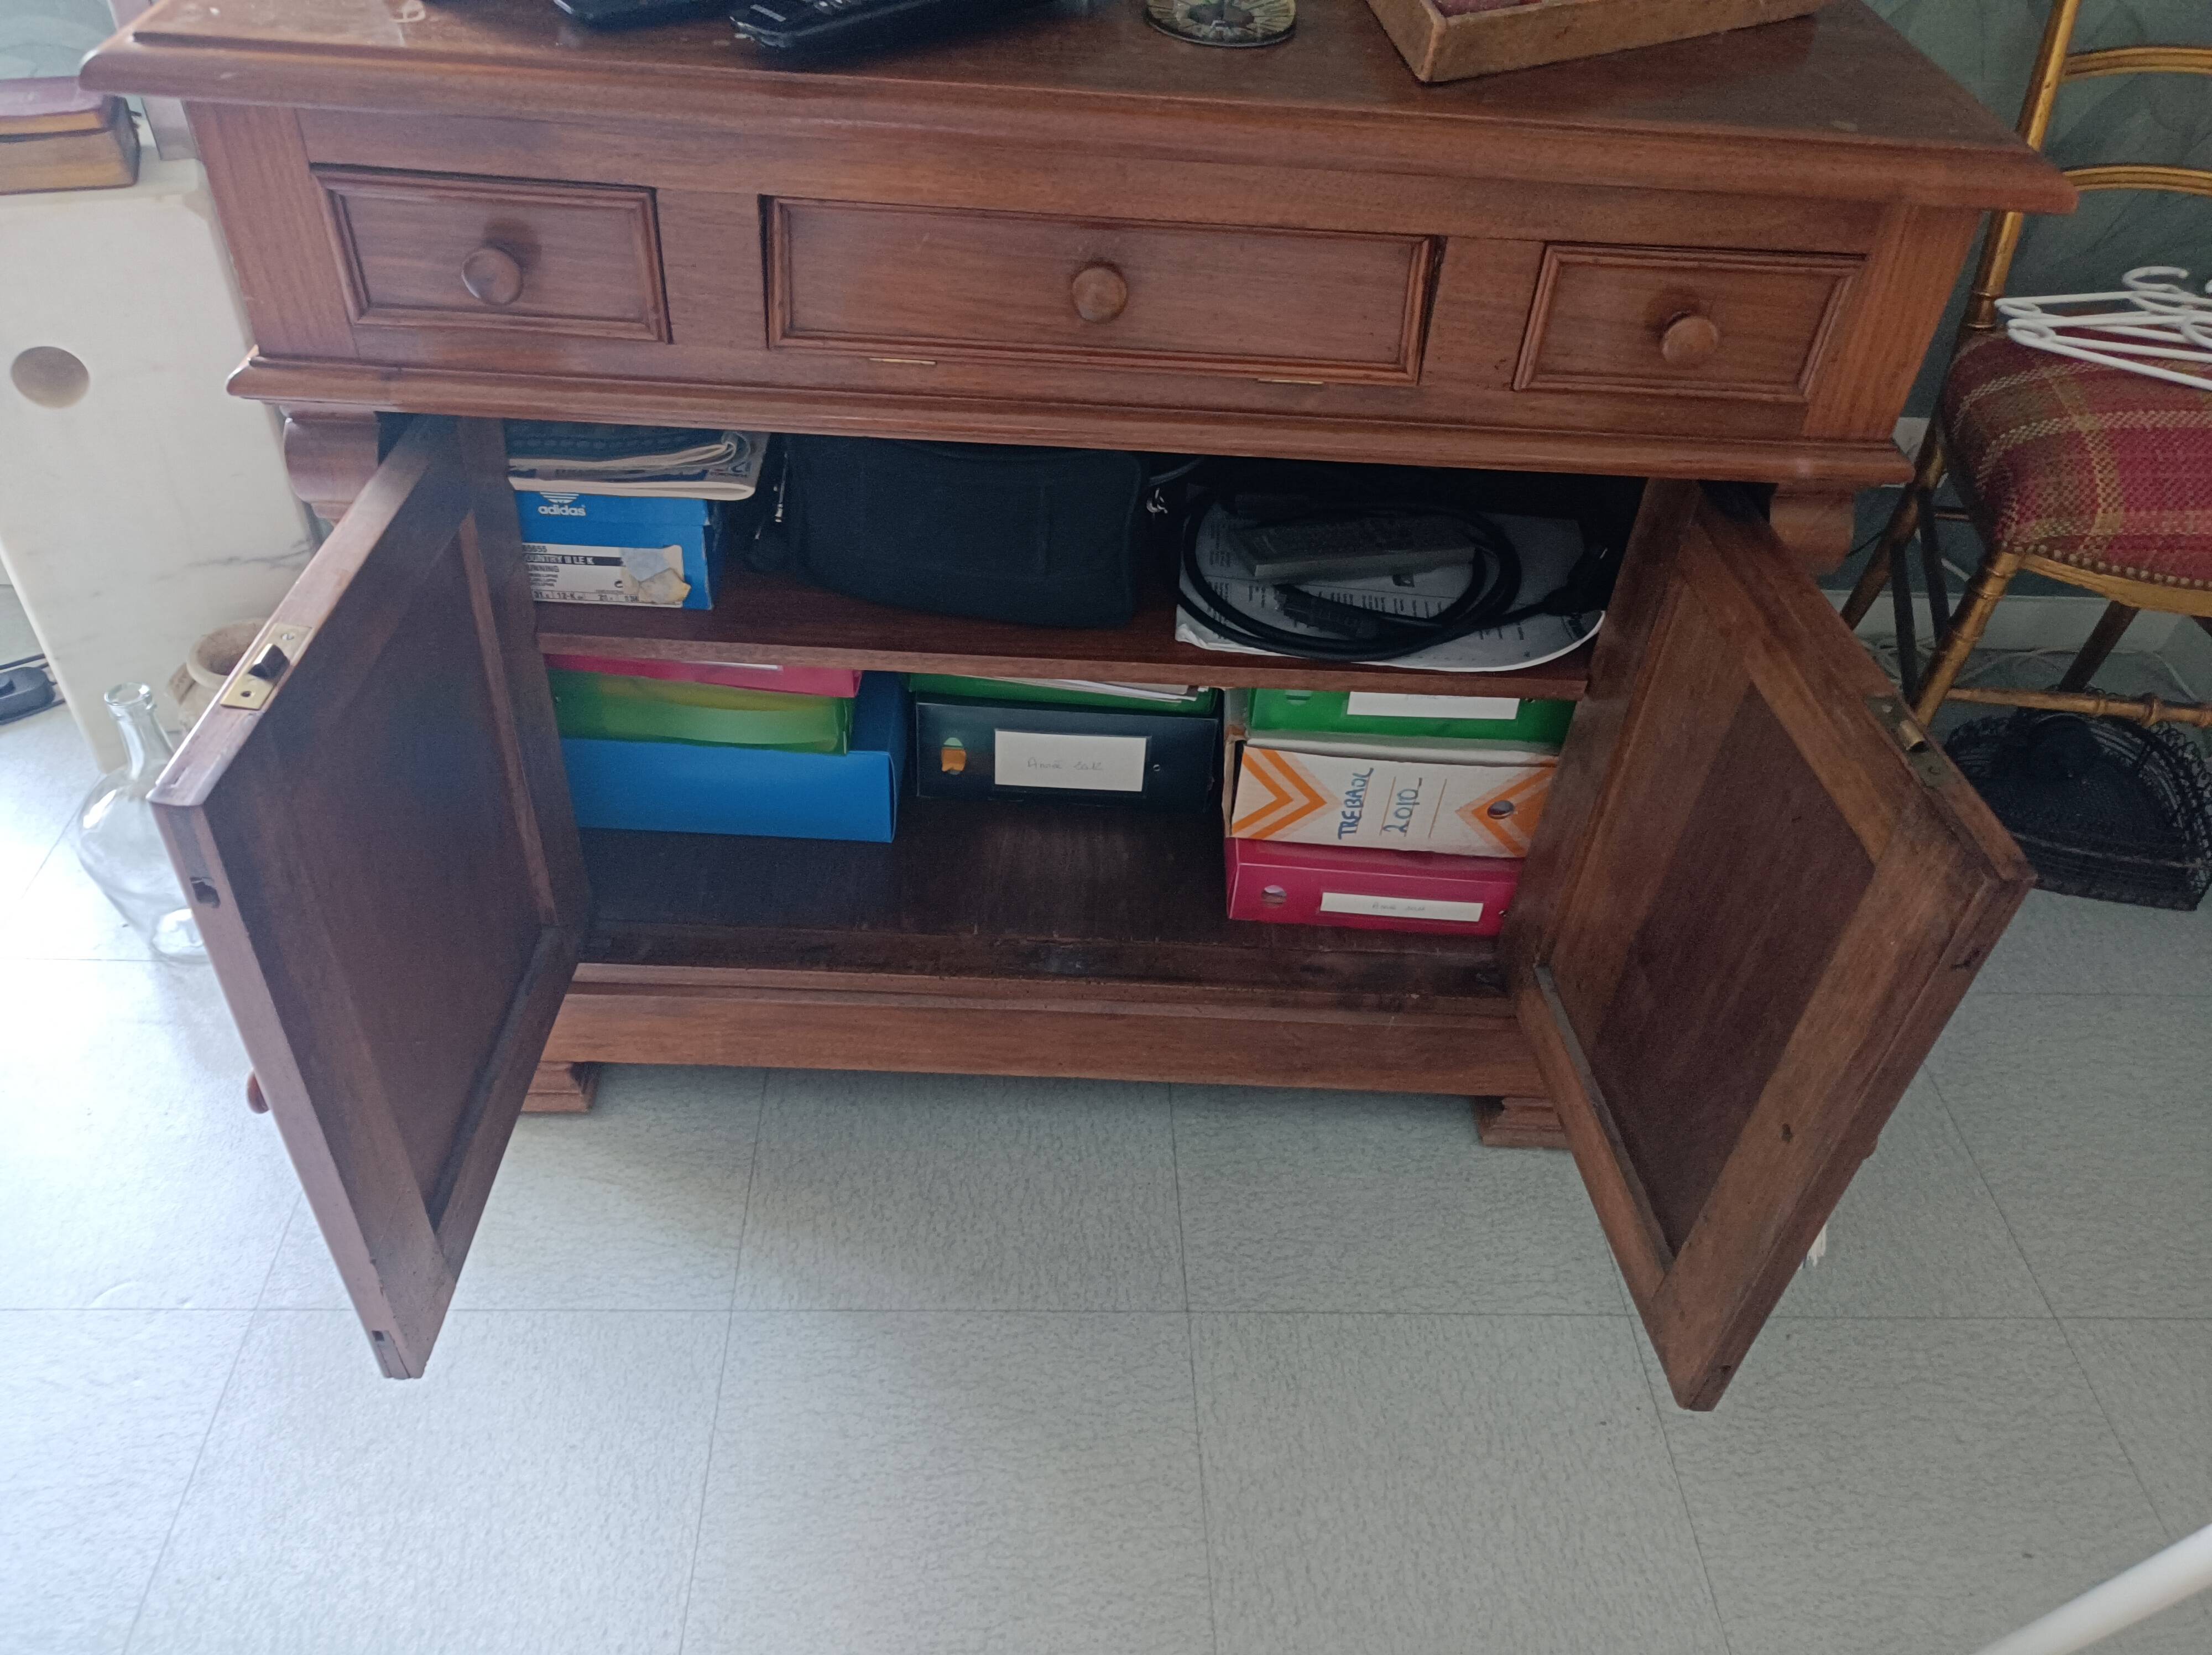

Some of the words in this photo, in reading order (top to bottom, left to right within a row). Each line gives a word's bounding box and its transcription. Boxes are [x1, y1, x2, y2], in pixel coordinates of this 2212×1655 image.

[538, 504, 586, 516] adidas
[1338, 767, 1374, 840] TREBAOL
[1383, 777, 1422, 834] 2010
